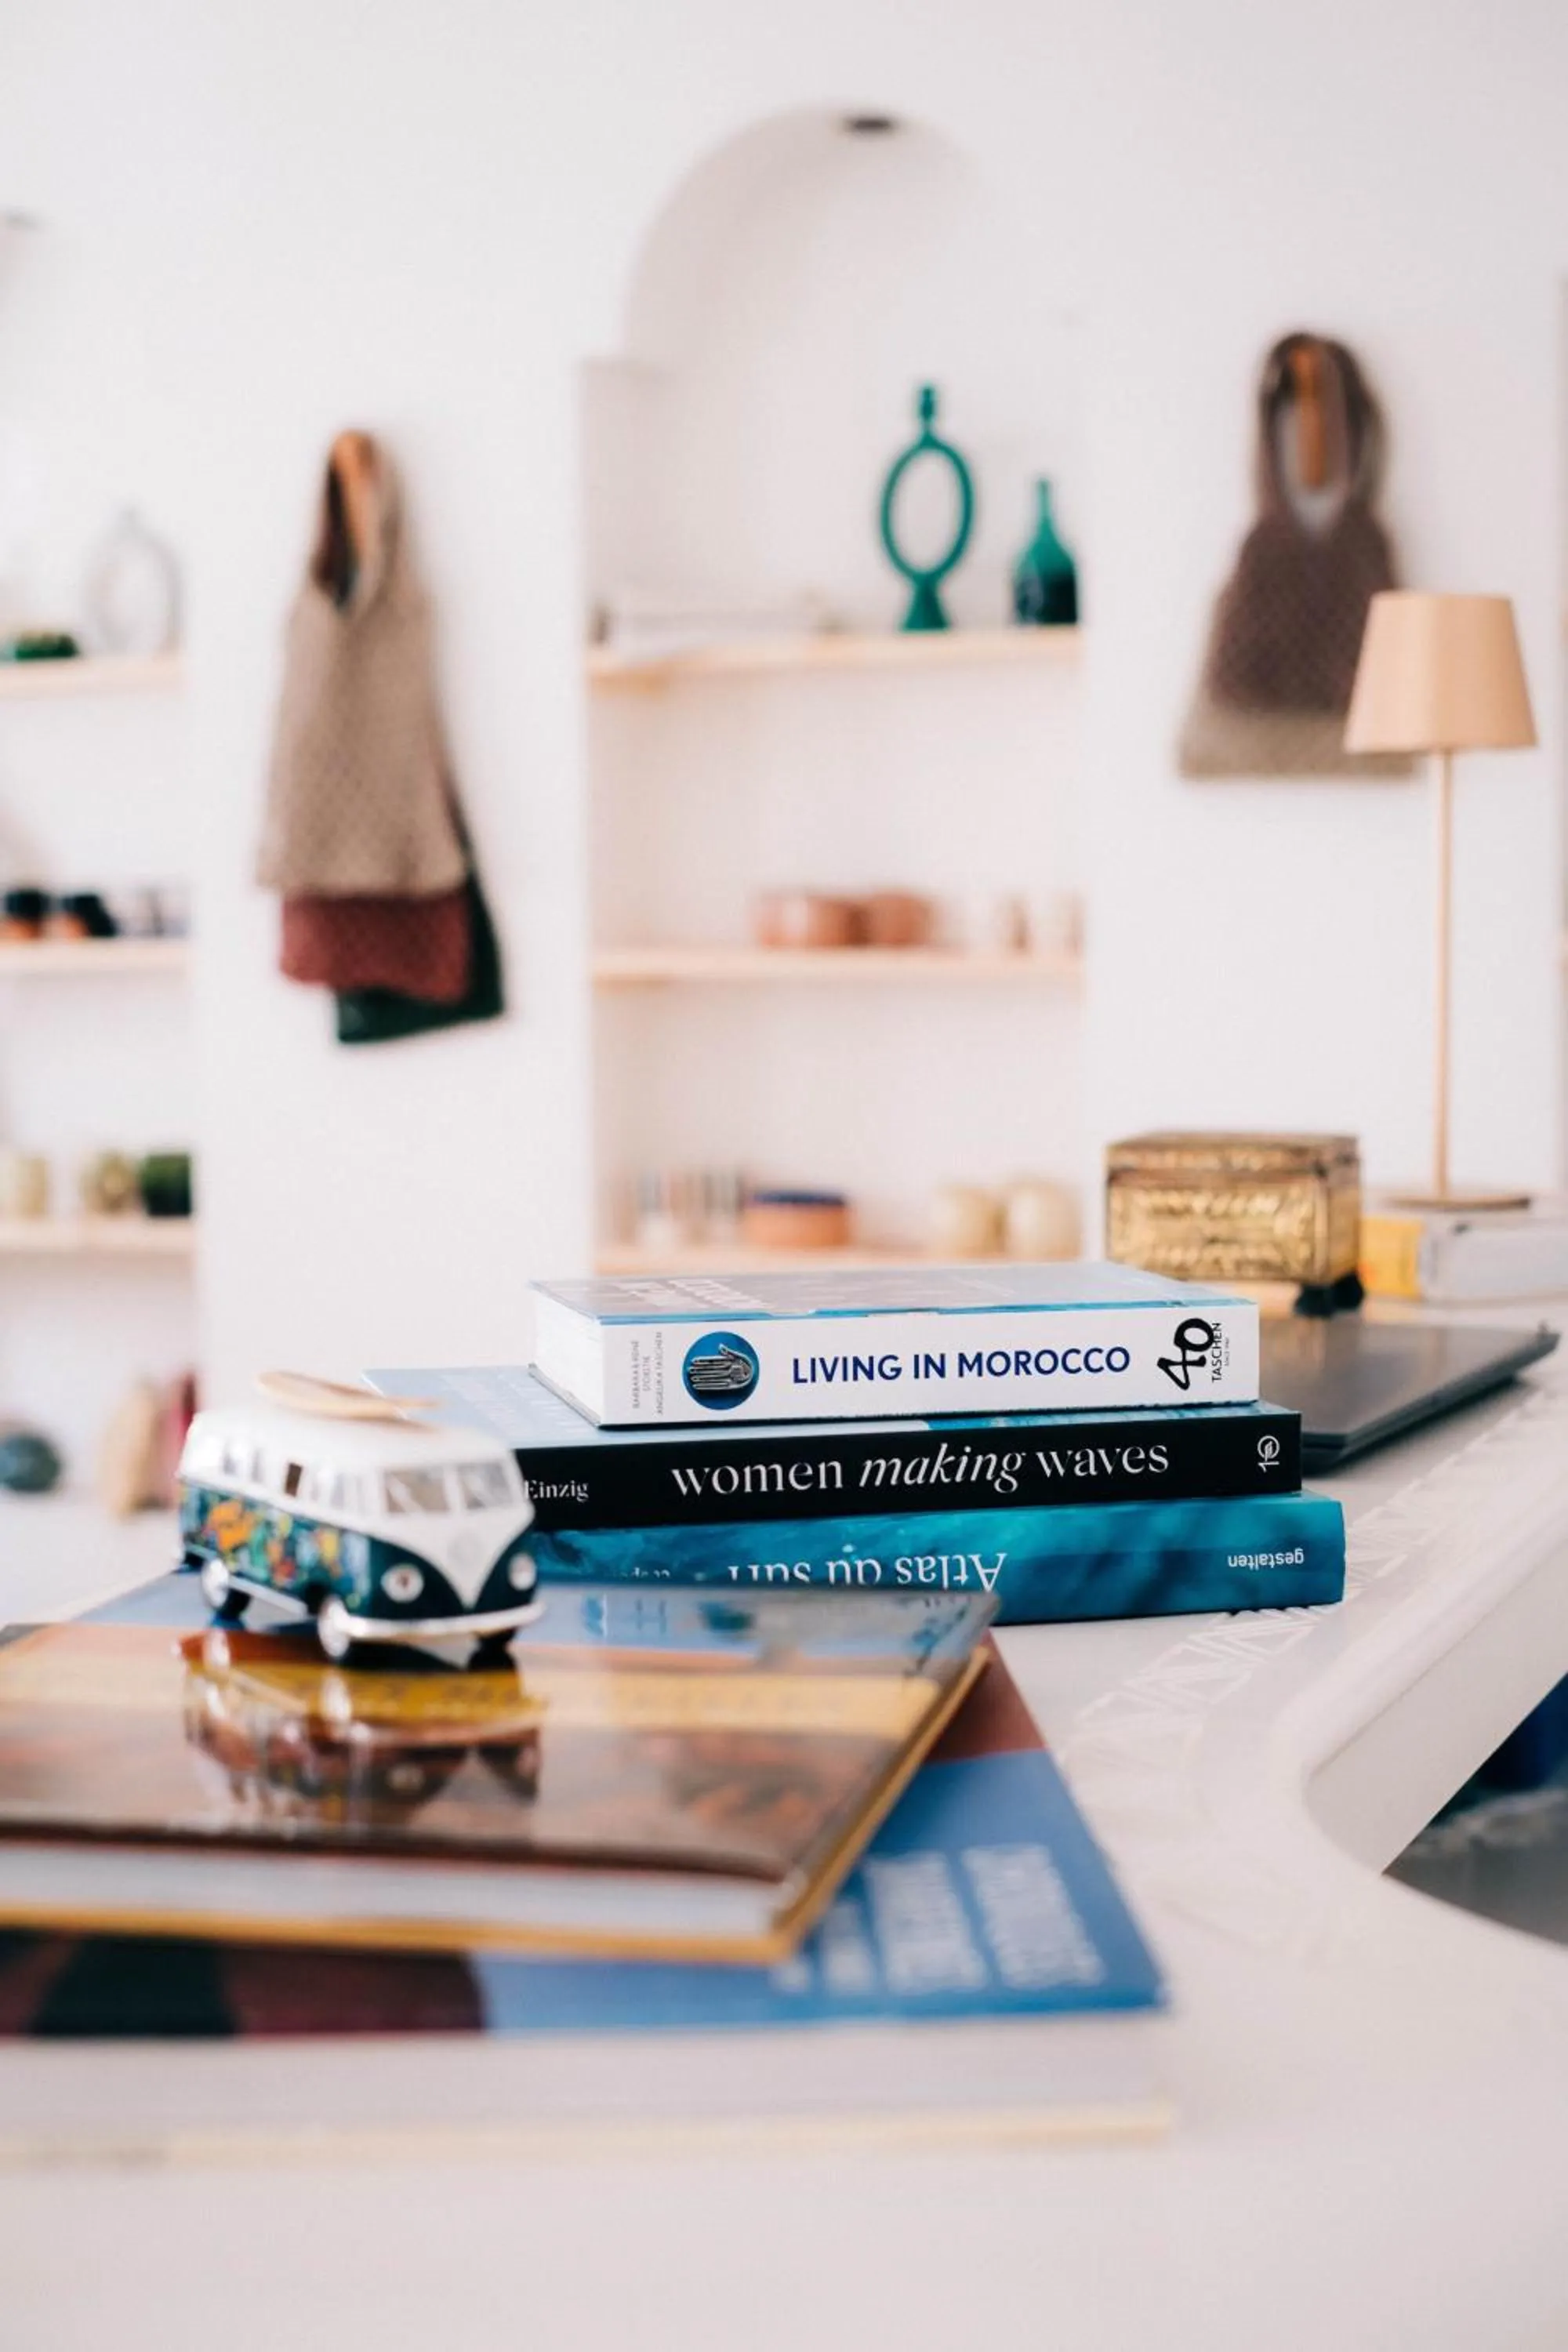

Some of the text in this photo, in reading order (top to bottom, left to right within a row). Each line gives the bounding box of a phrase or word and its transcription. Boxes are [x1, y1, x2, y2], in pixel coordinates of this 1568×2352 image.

[793, 1346, 1131, 1384] LIVING IN MOROCCO
[1156, 1318, 1215, 1390] 40
[1211, 1322, 1223, 1382] TASCHEN
[671, 1443, 1169, 1495] women making waves
[524, 1479, 590, 1504] Einzig
[895, 1553, 1007, 1592] Atlas
[1228, 1547, 1305, 1569] gestalten
